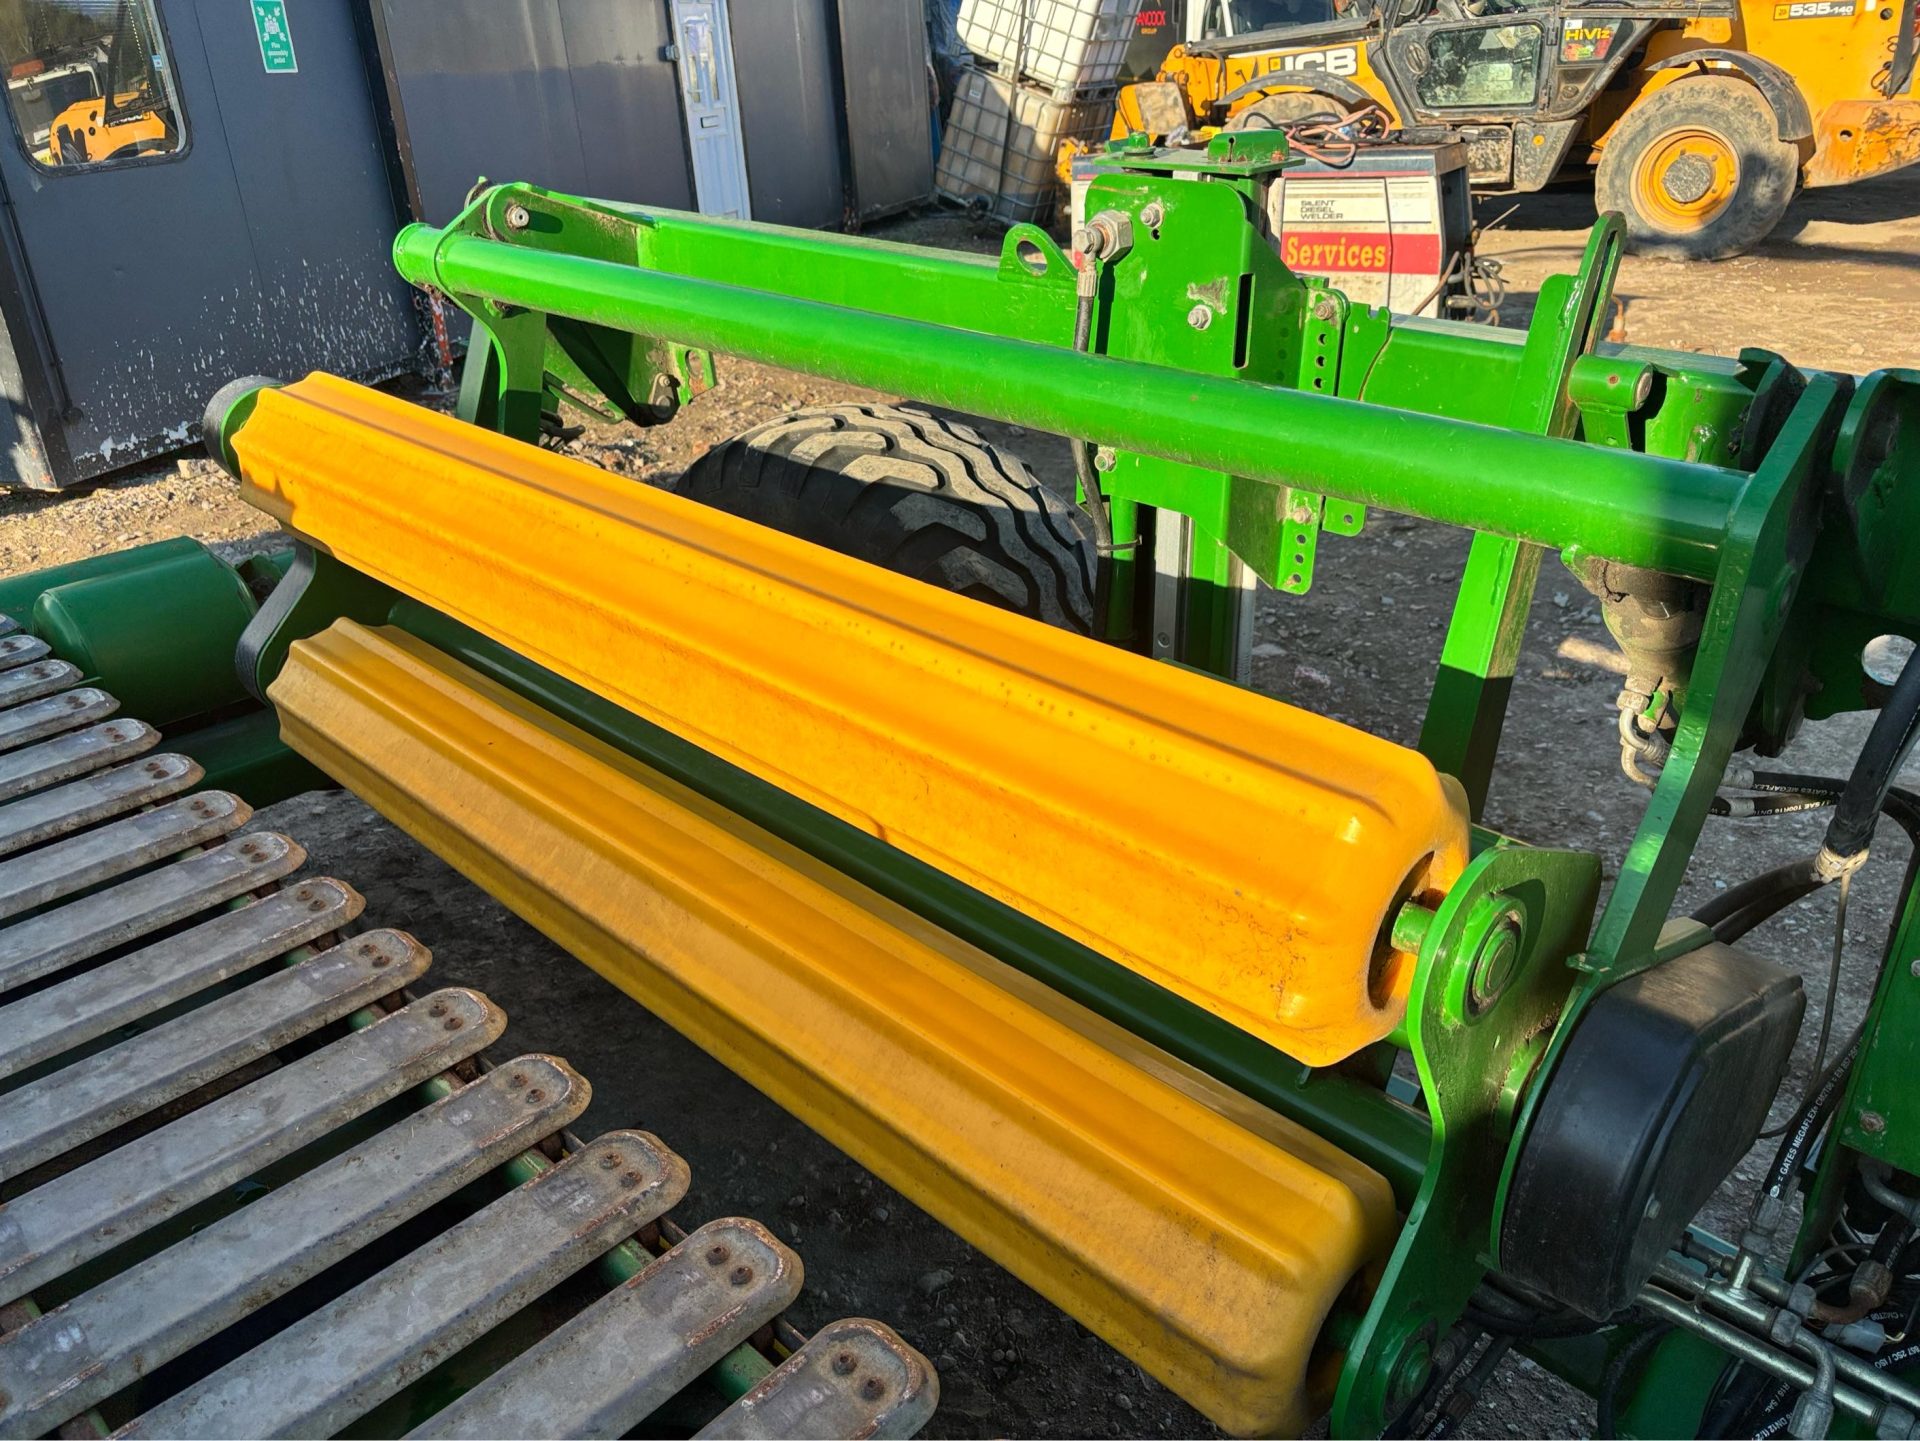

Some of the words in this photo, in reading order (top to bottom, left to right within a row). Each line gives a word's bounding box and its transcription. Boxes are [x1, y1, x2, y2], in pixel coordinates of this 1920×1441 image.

[1136, 11, 1166, 26] ANCOCK
[1285, 48, 1357, 76] JCB
[1286, 236, 1387, 268] Services
[1780, 1147, 1797, 1175] GATES
